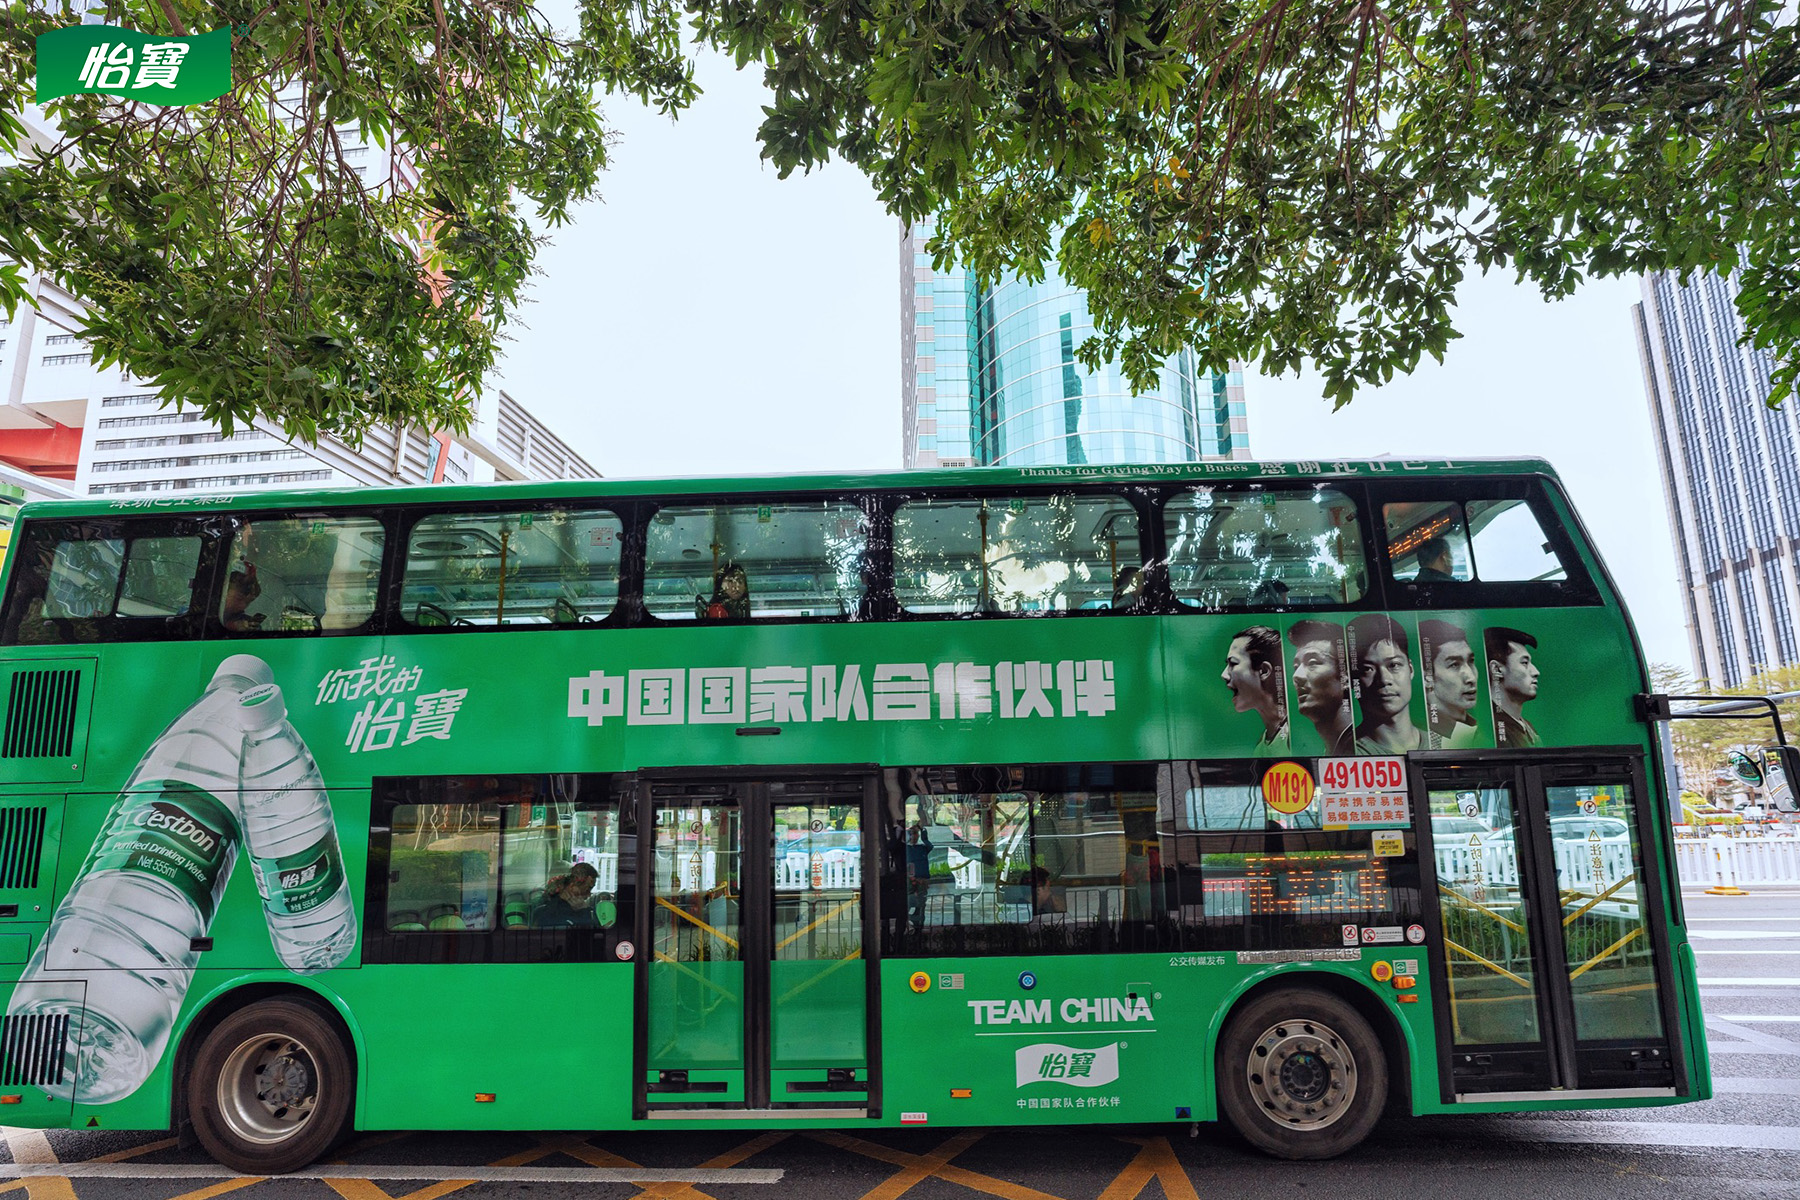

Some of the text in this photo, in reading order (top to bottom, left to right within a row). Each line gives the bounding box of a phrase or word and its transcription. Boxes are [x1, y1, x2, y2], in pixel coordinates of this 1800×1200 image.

[1018, 463, 1249, 477] Thanks for Giving Way to Buses
[315, 655, 423, 705] 你我的
[567, 659, 1116, 727] 中国国家队合作伙伴
[345, 688, 468, 753] 怡寶
[1268, 772, 1309, 804] M191
[1324, 761, 1402, 789] 49105D
[1326, 796, 1404, 808] 严禁携带易燃
[1327, 810, 1405, 822] 易爆危险品乘车
[137, 855, 177, 879] Net 555ml
[148, 843, 186, 865] Drinking
[184, 860, 207, 882] Water
[1169, 956, 1225, 967] 公交传媒发布
[967, 997, 1155, 1025] TEAM CHINA
[1038, 1052, 1096, 1078] 怡寶
[1016, 1097, 1121, 1109] 中国国家队合作伙伴
